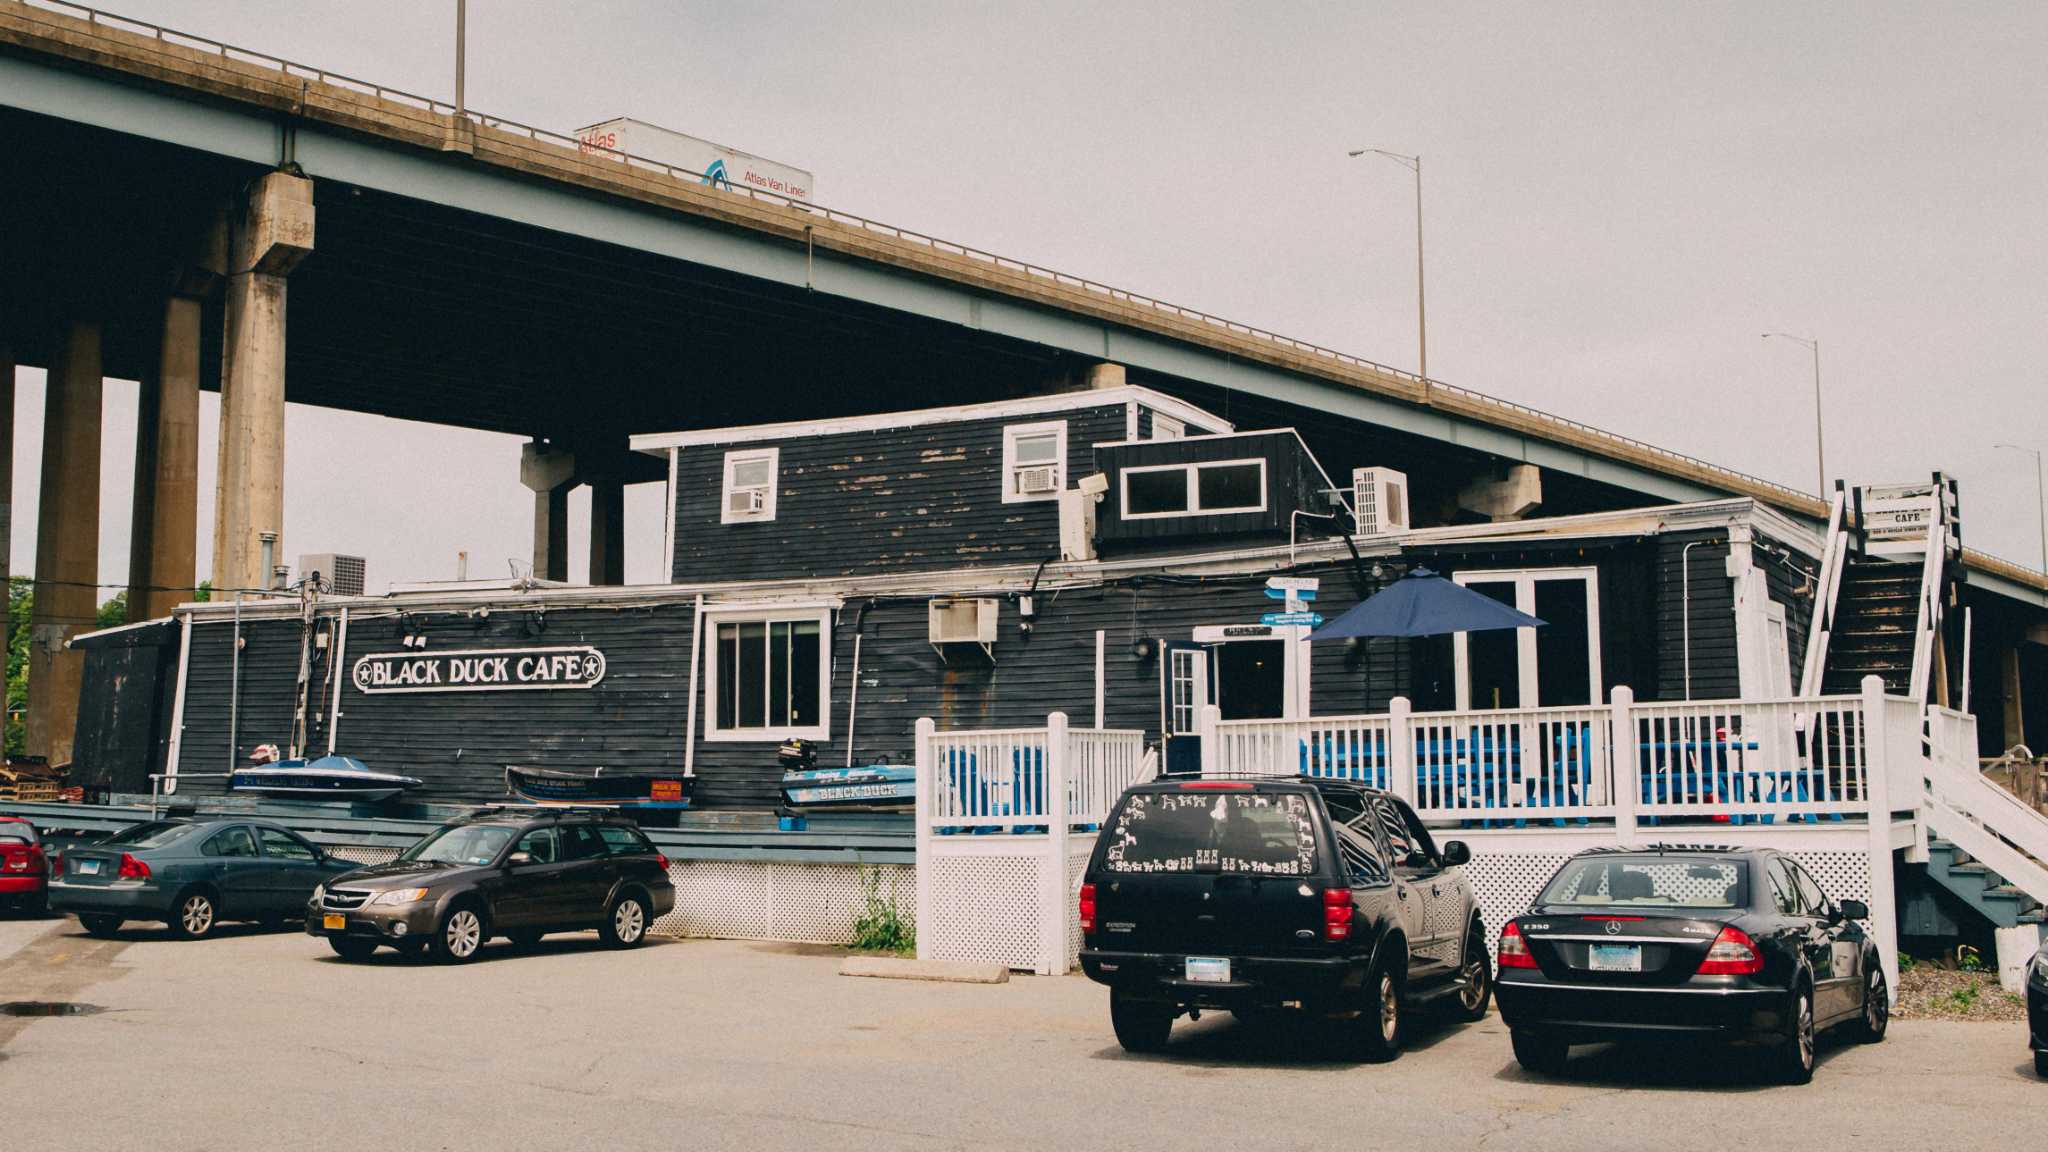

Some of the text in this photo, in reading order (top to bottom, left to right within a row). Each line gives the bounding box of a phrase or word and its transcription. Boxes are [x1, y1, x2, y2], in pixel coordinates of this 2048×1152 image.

[744, 170, 767, 187] Atlas
[767, 176, 784, 191] Van
[1895, 512, 1921, 523] CAFE
[372, 655, 582, 685] BLACK DUCK CAFE
[819, 784, 898, 800] BLACK DUCK
